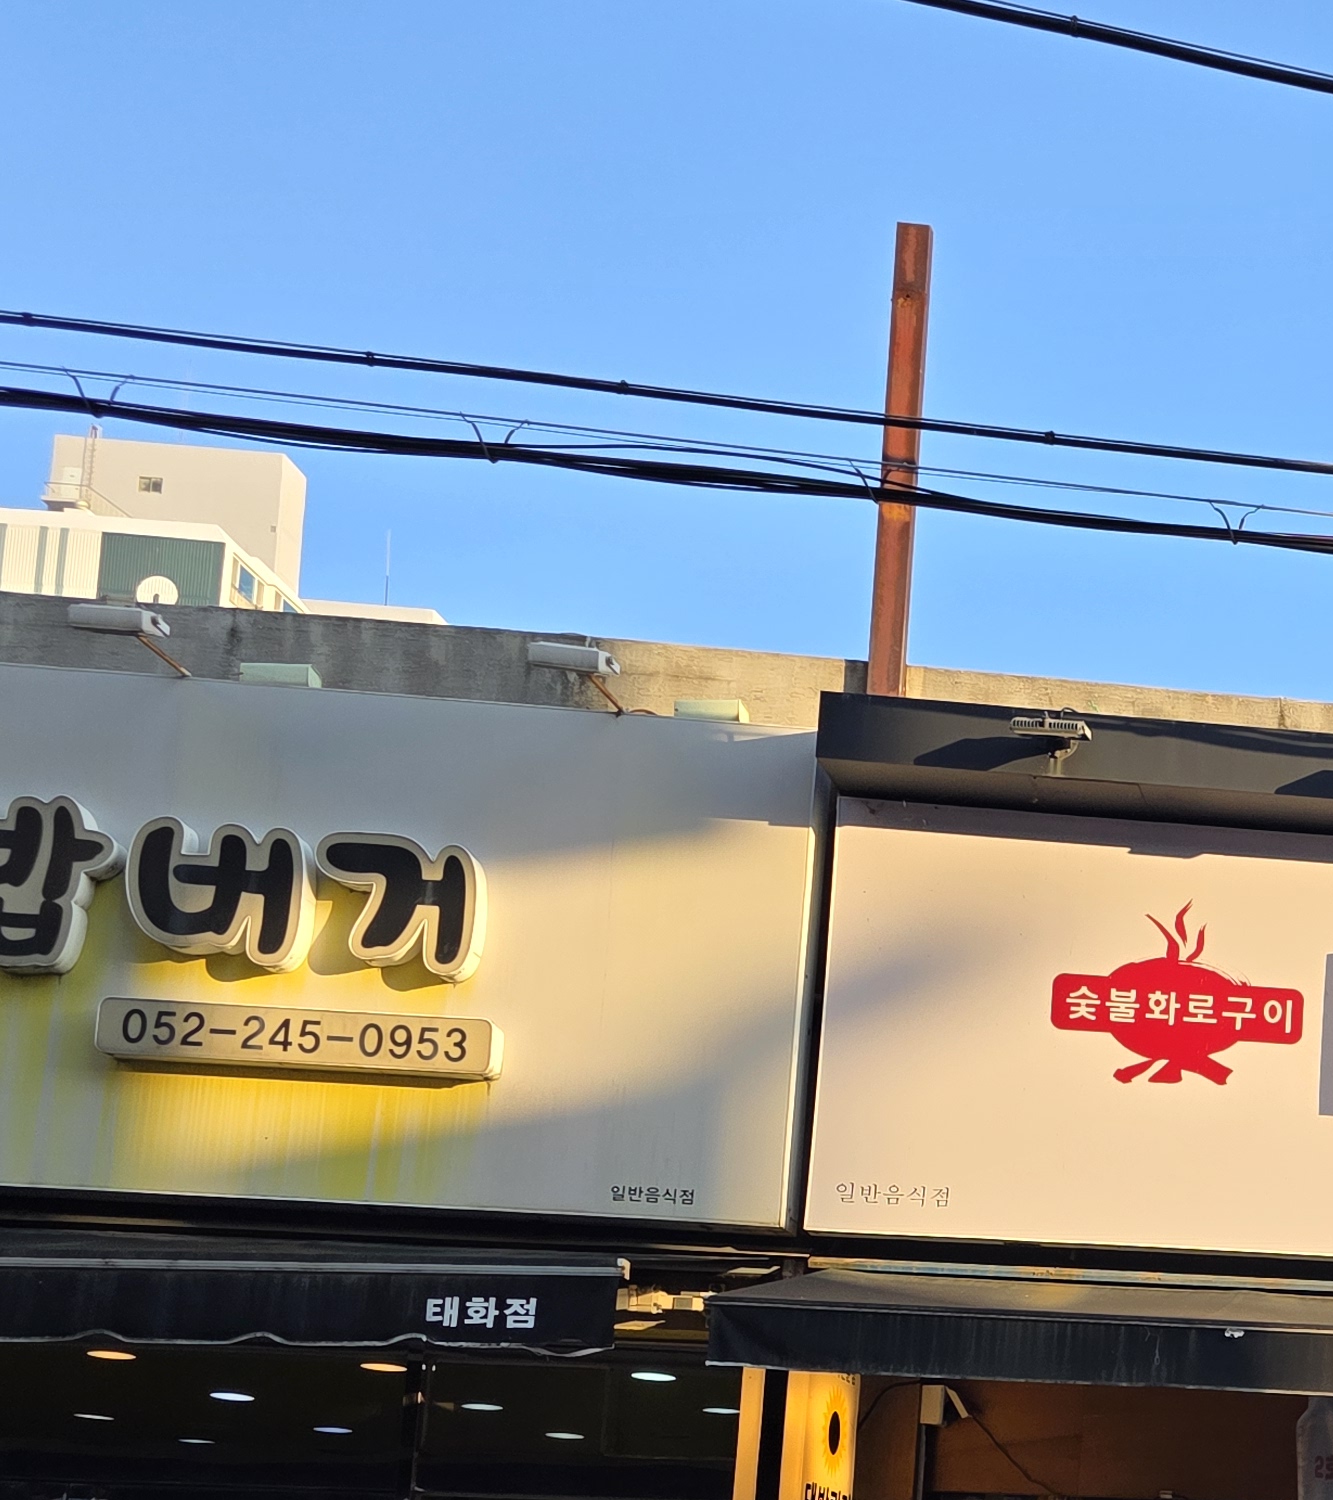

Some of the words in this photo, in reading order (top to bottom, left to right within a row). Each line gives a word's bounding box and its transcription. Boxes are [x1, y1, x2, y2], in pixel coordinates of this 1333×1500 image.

[1065, 987, 1295, 1035] 숯불화로구이
[121, 1008, 468, 1063] 052-245-0953
[610, 1184, 696, 1206] 일반음식점
[835, 1180, 952, 1209] 일반음식점
[425, 1296, 538, 1330] 태화점
